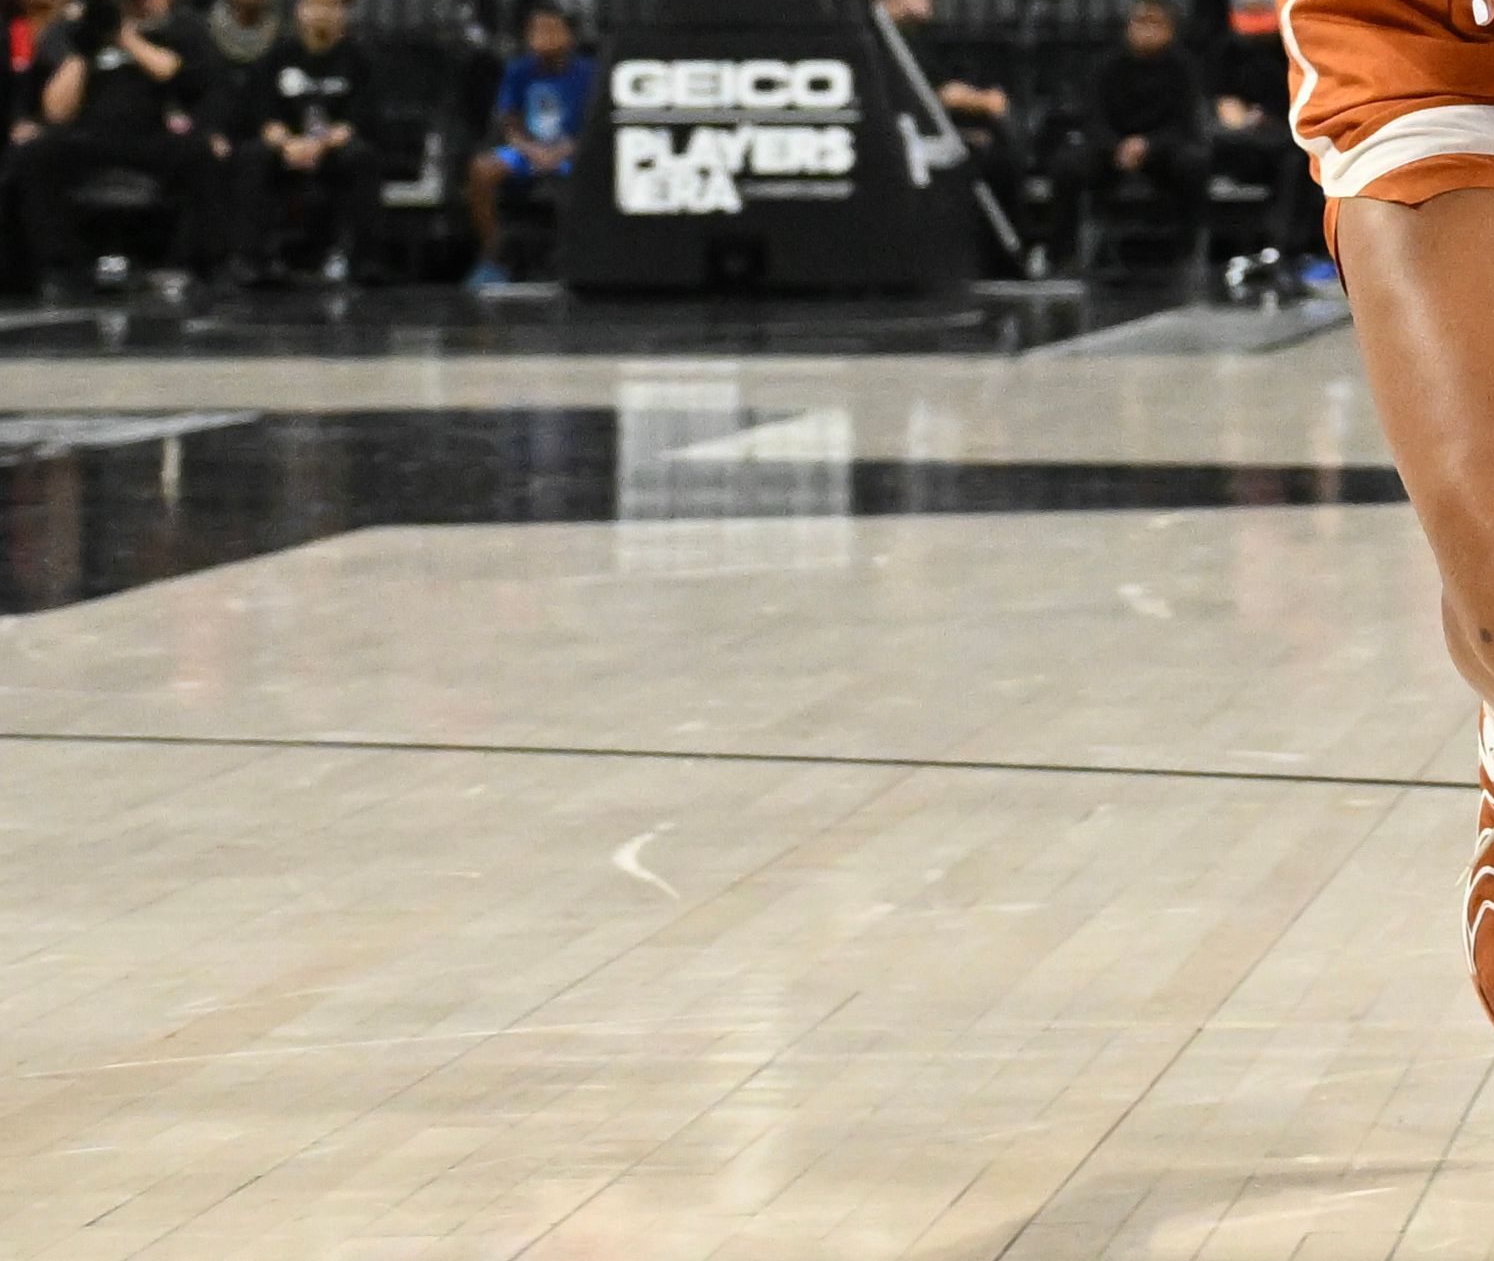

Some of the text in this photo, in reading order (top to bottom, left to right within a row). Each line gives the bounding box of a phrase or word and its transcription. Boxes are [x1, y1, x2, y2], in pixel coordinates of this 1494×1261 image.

[612, 59, 854, 109] GEICO
[615, 124, 856, 176] PLAYERS
[615, 168, 744, 215] ERA
